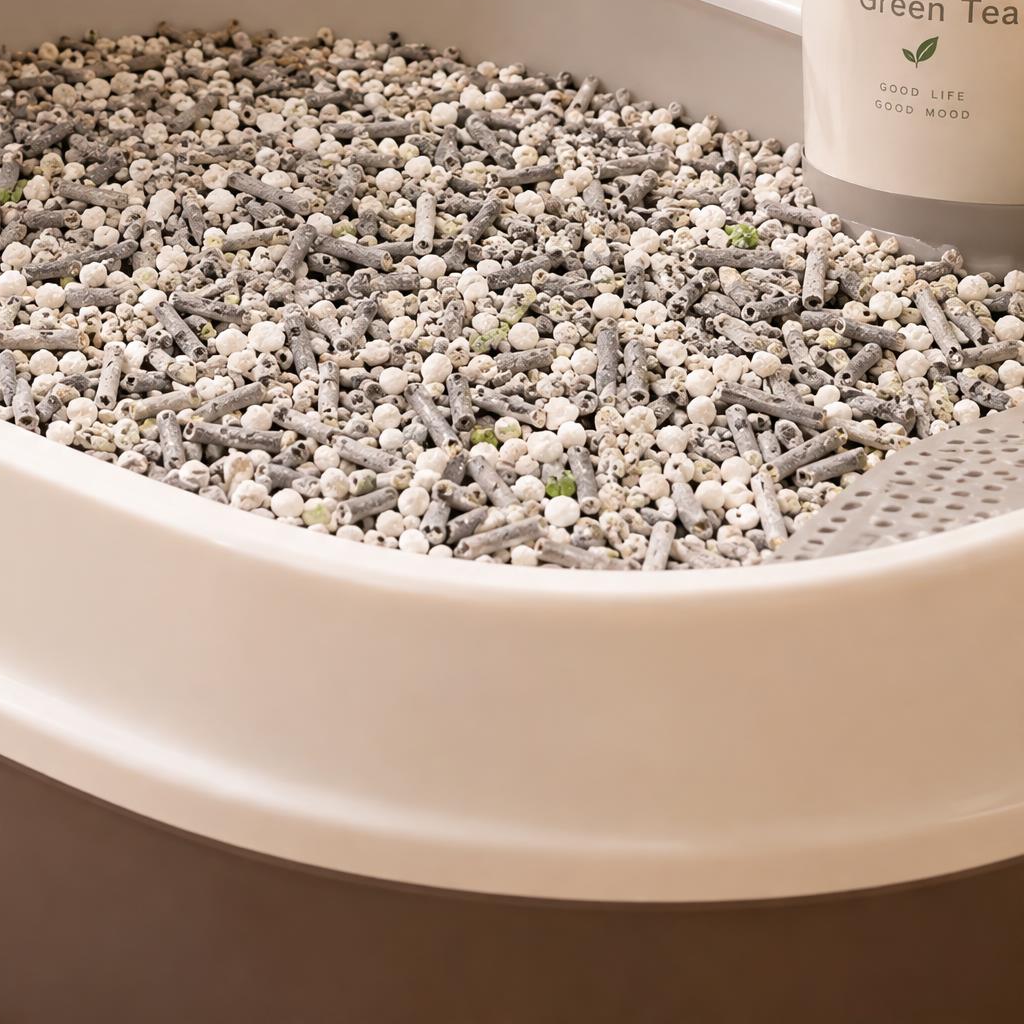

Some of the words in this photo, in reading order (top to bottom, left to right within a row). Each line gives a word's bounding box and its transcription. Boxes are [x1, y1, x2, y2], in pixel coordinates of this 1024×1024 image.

[879, 82, 919, 97] GOOD
[931, 89, 965, 101] LIFE
[875, 100, 914, 114] GOOD
[925, 108, 970, 120] MOOD
